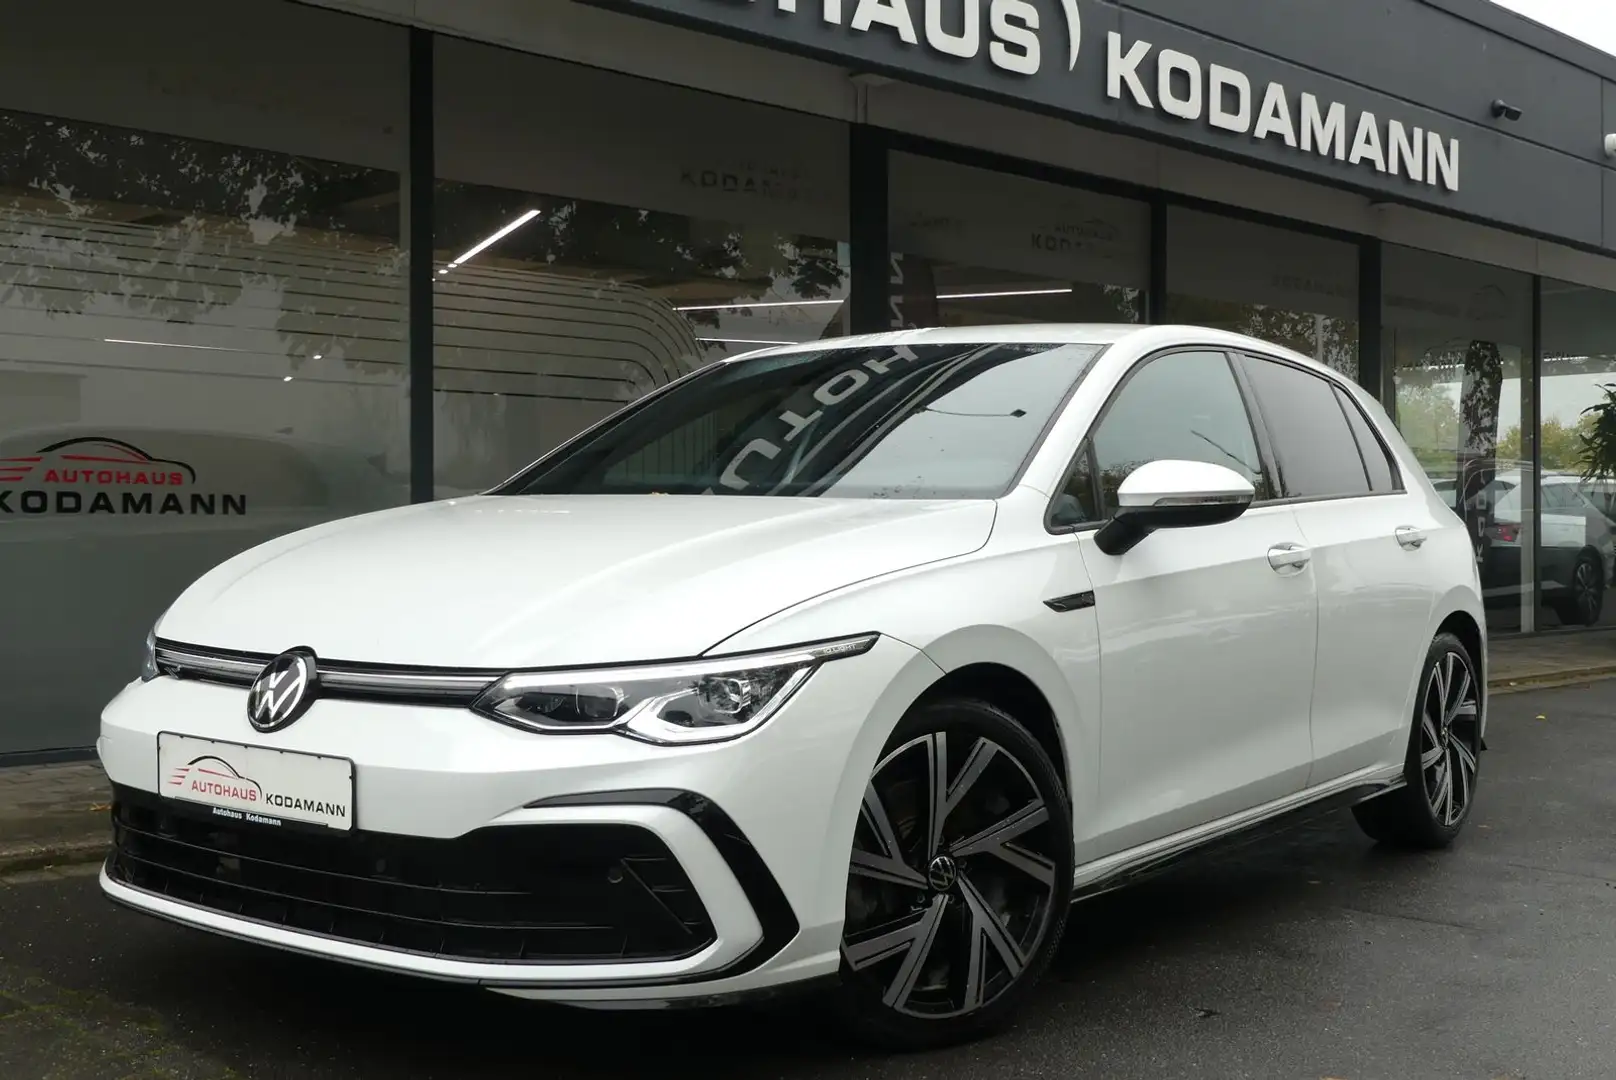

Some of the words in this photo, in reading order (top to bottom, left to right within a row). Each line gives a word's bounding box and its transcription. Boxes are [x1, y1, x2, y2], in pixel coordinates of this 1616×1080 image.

[1107, 31, 1459, 191] KODAMANN
[44, 469, 184, 486] AUTOHAUS
[191, 779, 257, 801] AUTOHAUS
[265, 793, 346, 818] KODAMANN
[212, 806, 243, 820] Autohaus
[246, 813, 282, 827] Kodamann
